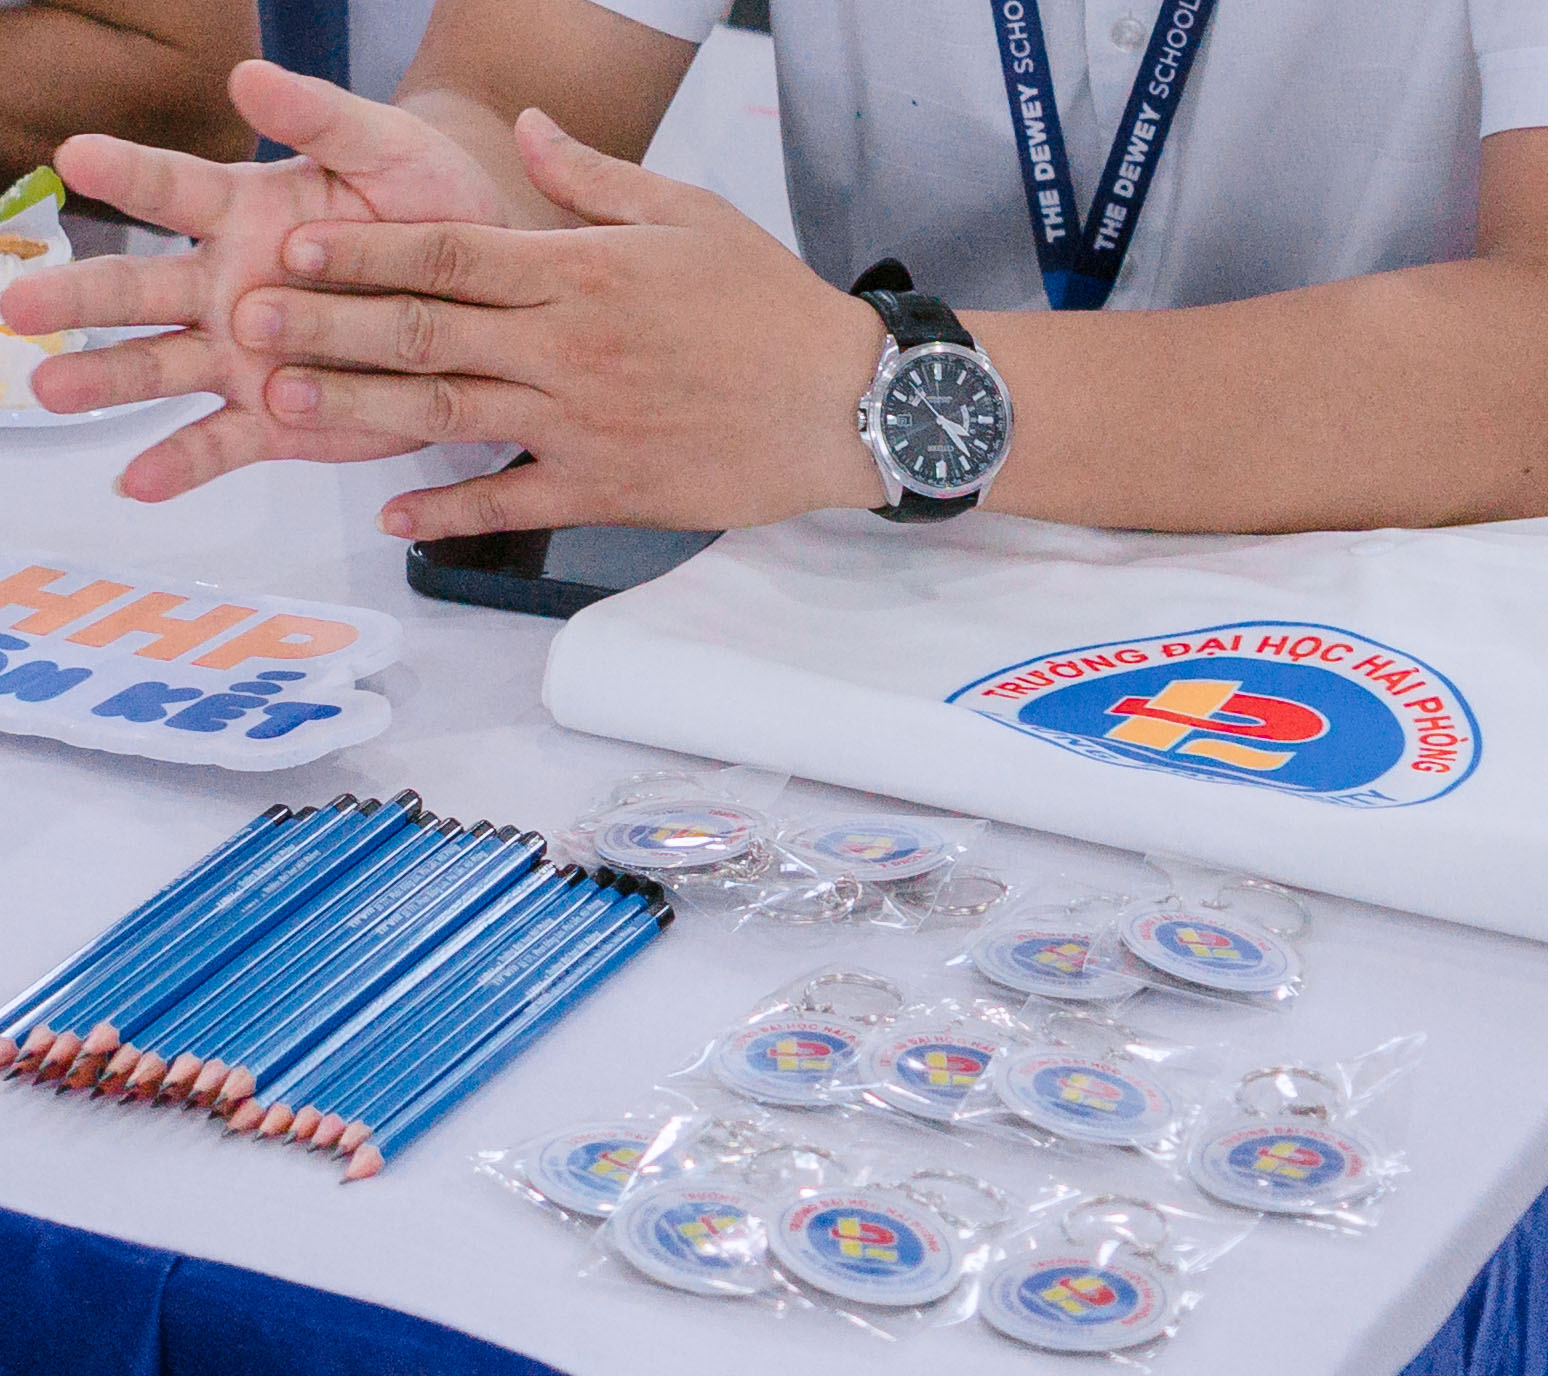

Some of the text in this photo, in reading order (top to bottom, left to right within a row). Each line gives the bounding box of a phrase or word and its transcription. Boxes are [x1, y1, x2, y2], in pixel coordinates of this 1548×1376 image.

[1017, 83, 1055, 182] DEWEY
[1093, 202, 1128, 250] THE
[1113, 101, 1162, 199] DEWEY
[1036, 189, 1066, 244] THE
[92, 669, 342, 739] KẾT
[981, 633, 1472, 776] TRƯỜNG ĐẠI HỌC HẢI PHÒNG
